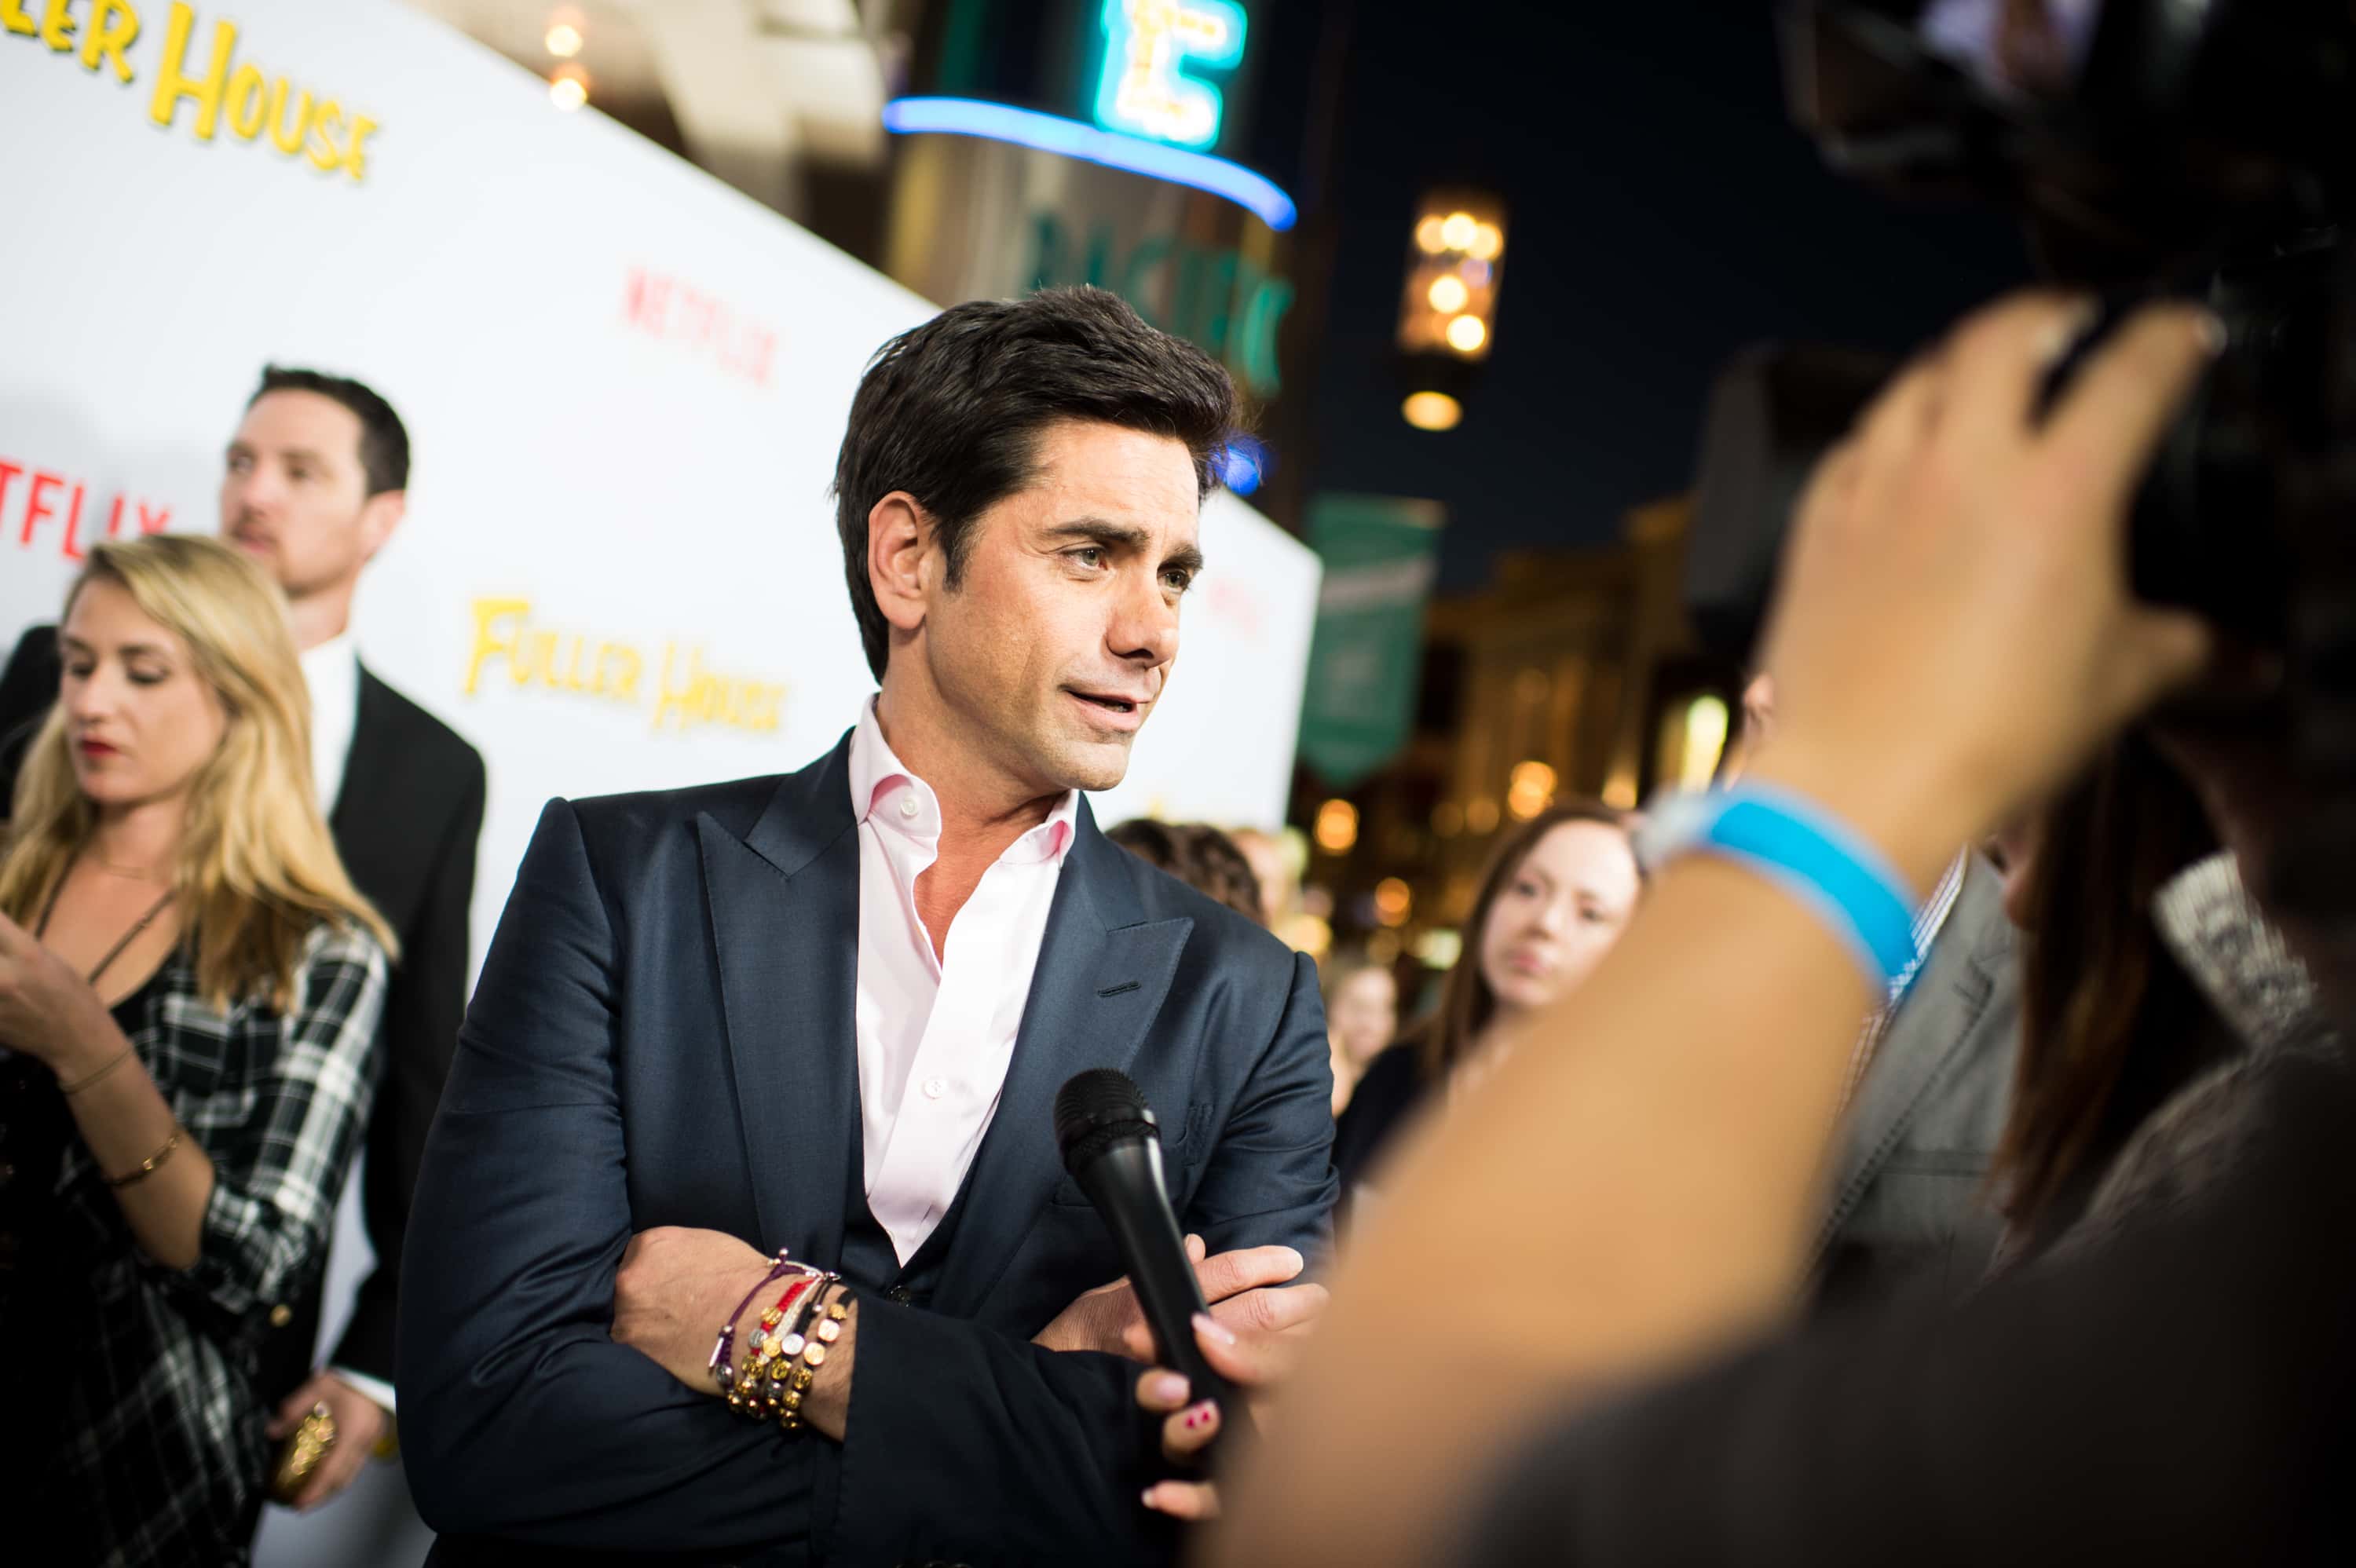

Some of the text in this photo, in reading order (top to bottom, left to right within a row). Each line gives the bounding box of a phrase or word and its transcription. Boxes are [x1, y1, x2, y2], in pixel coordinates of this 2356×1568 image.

[149, 1, 379, 181] HOUSE
[463, 597, 785, 732] FULLER HOUSE
